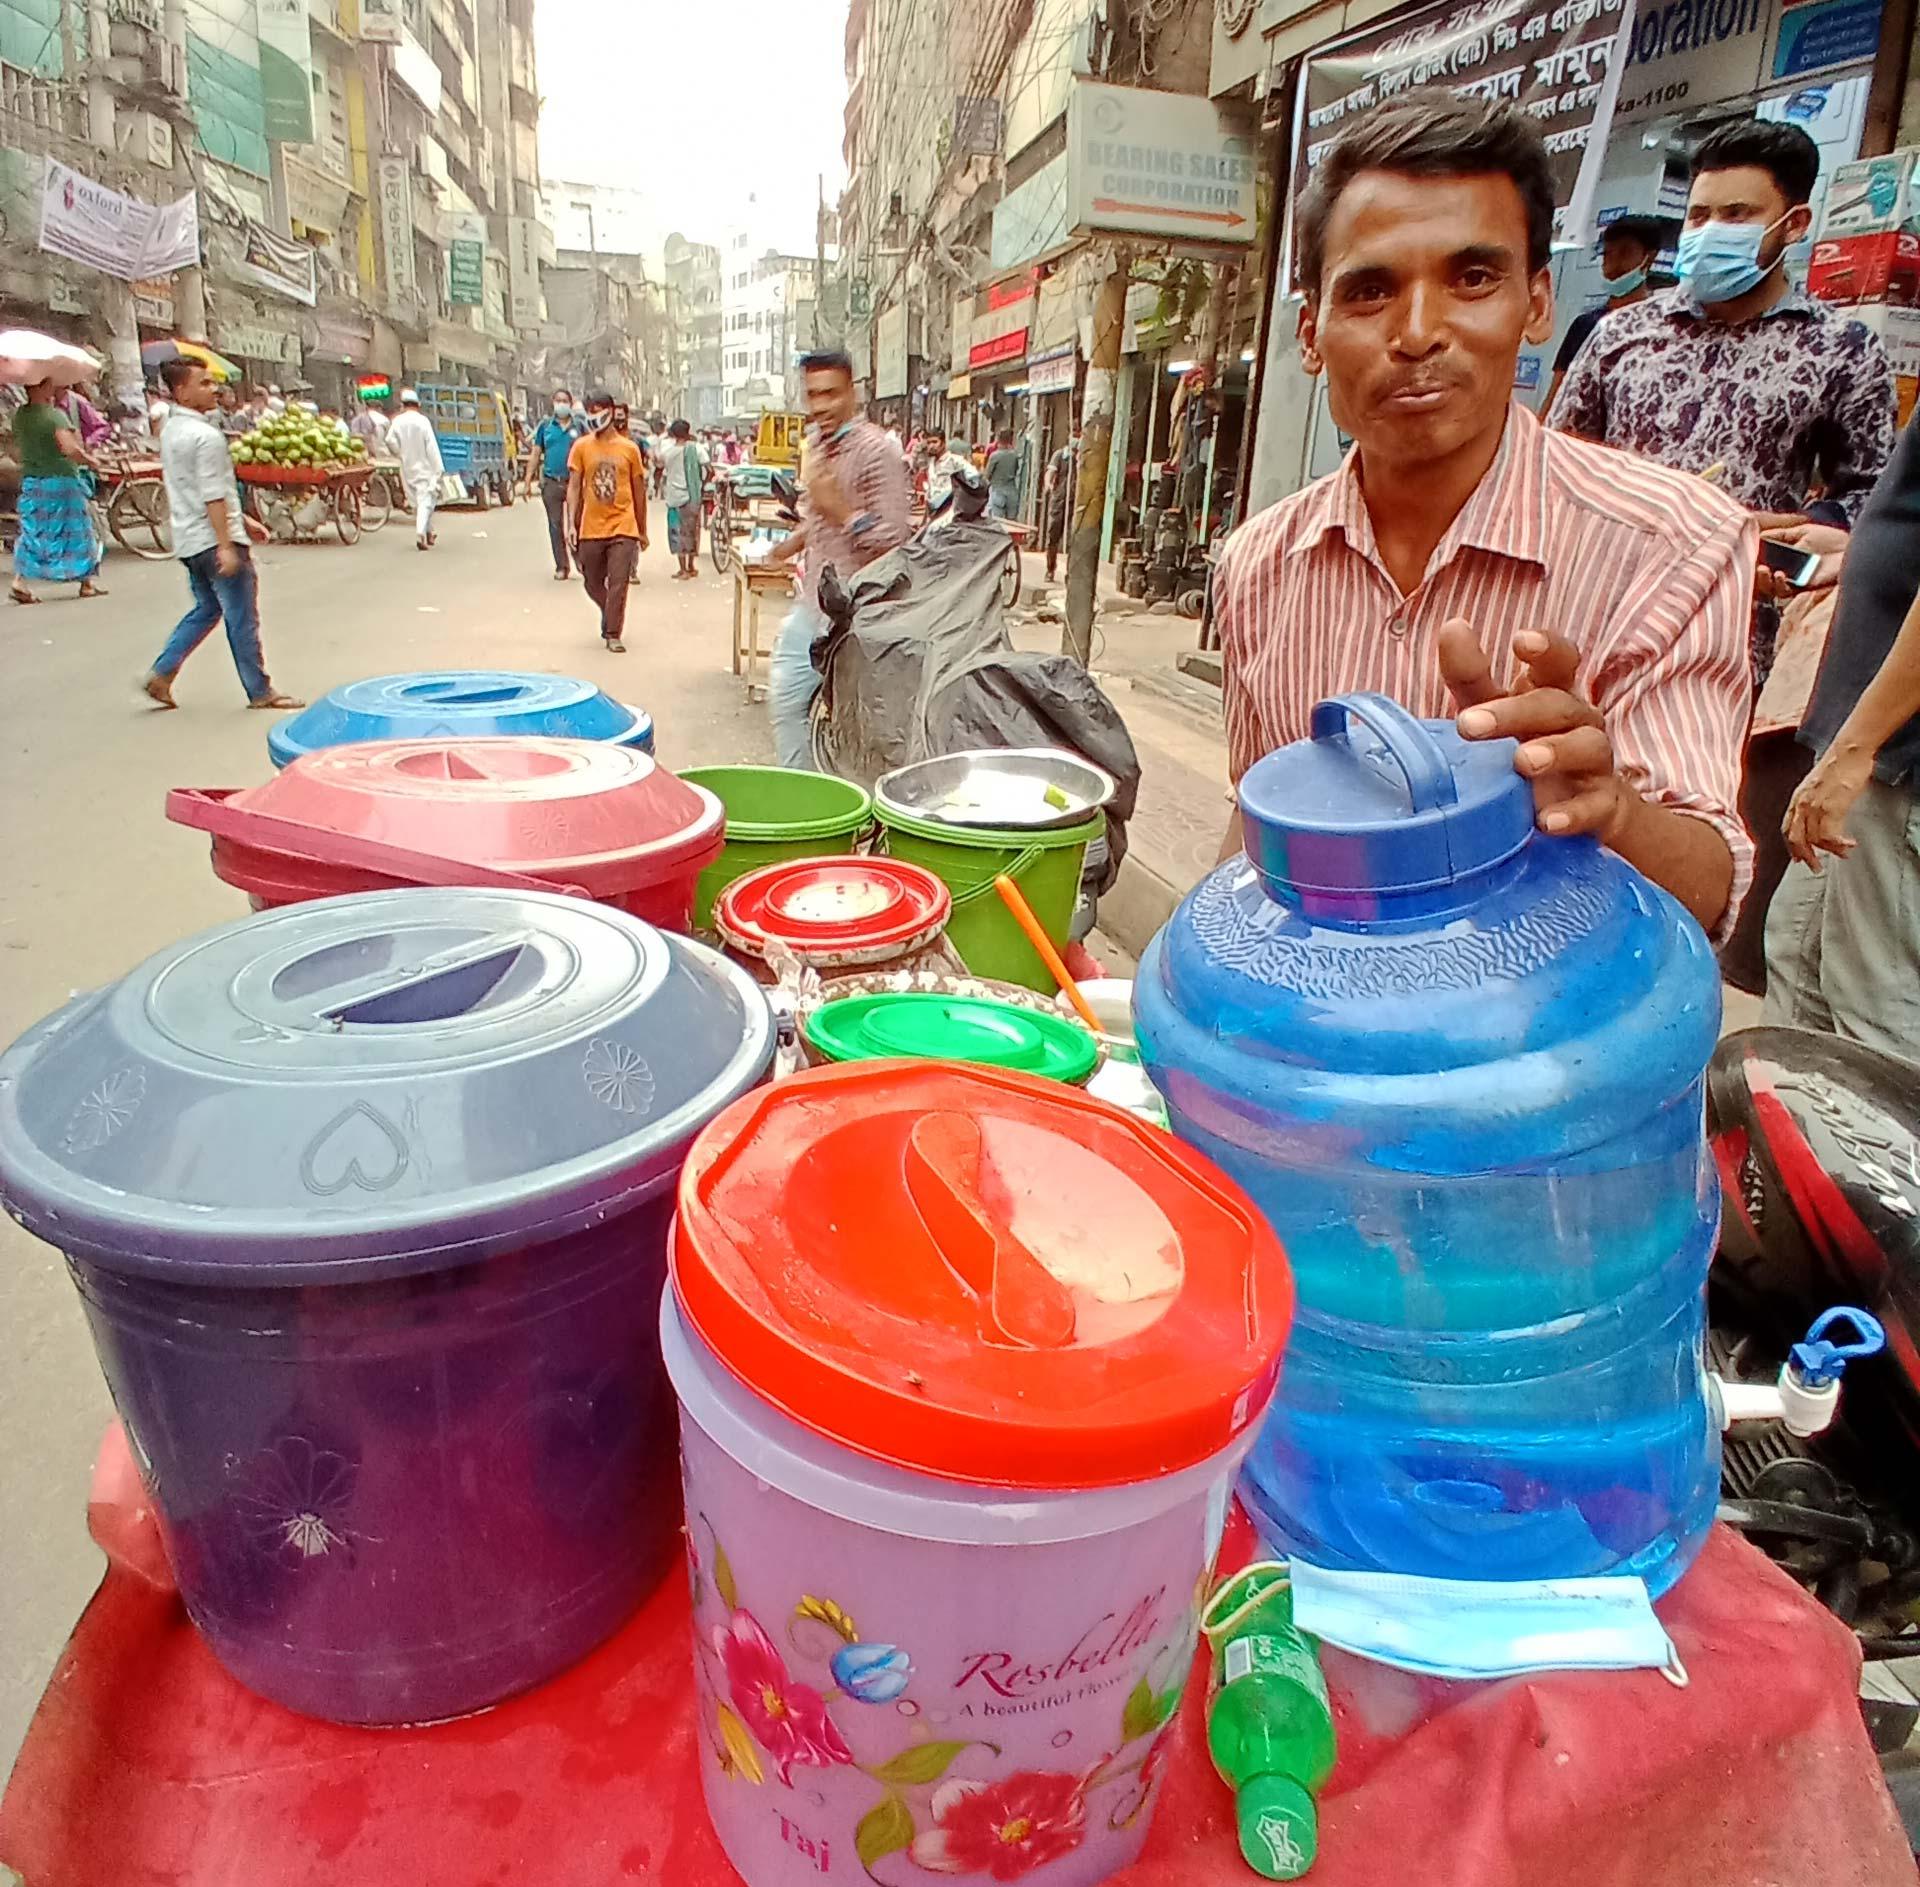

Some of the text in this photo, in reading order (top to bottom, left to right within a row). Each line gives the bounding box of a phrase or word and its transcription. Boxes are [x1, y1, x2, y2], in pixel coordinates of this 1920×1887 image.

[1521, 13, 1548, 41] এর
[1625, 0, 1759, 69] oration
[1613, 81, 1689, 115] ka-1100
[1087, 141, 1255, 184] BEARING SALES
[78, 185, 123, 216] oxford
[1102, 173, 1240, 209] CORPORATION
[959, 1703, 974, 1718] A
[983, 1689, 1072, 1717] beautiful
[772, 1807, 829, 1873] Taj
